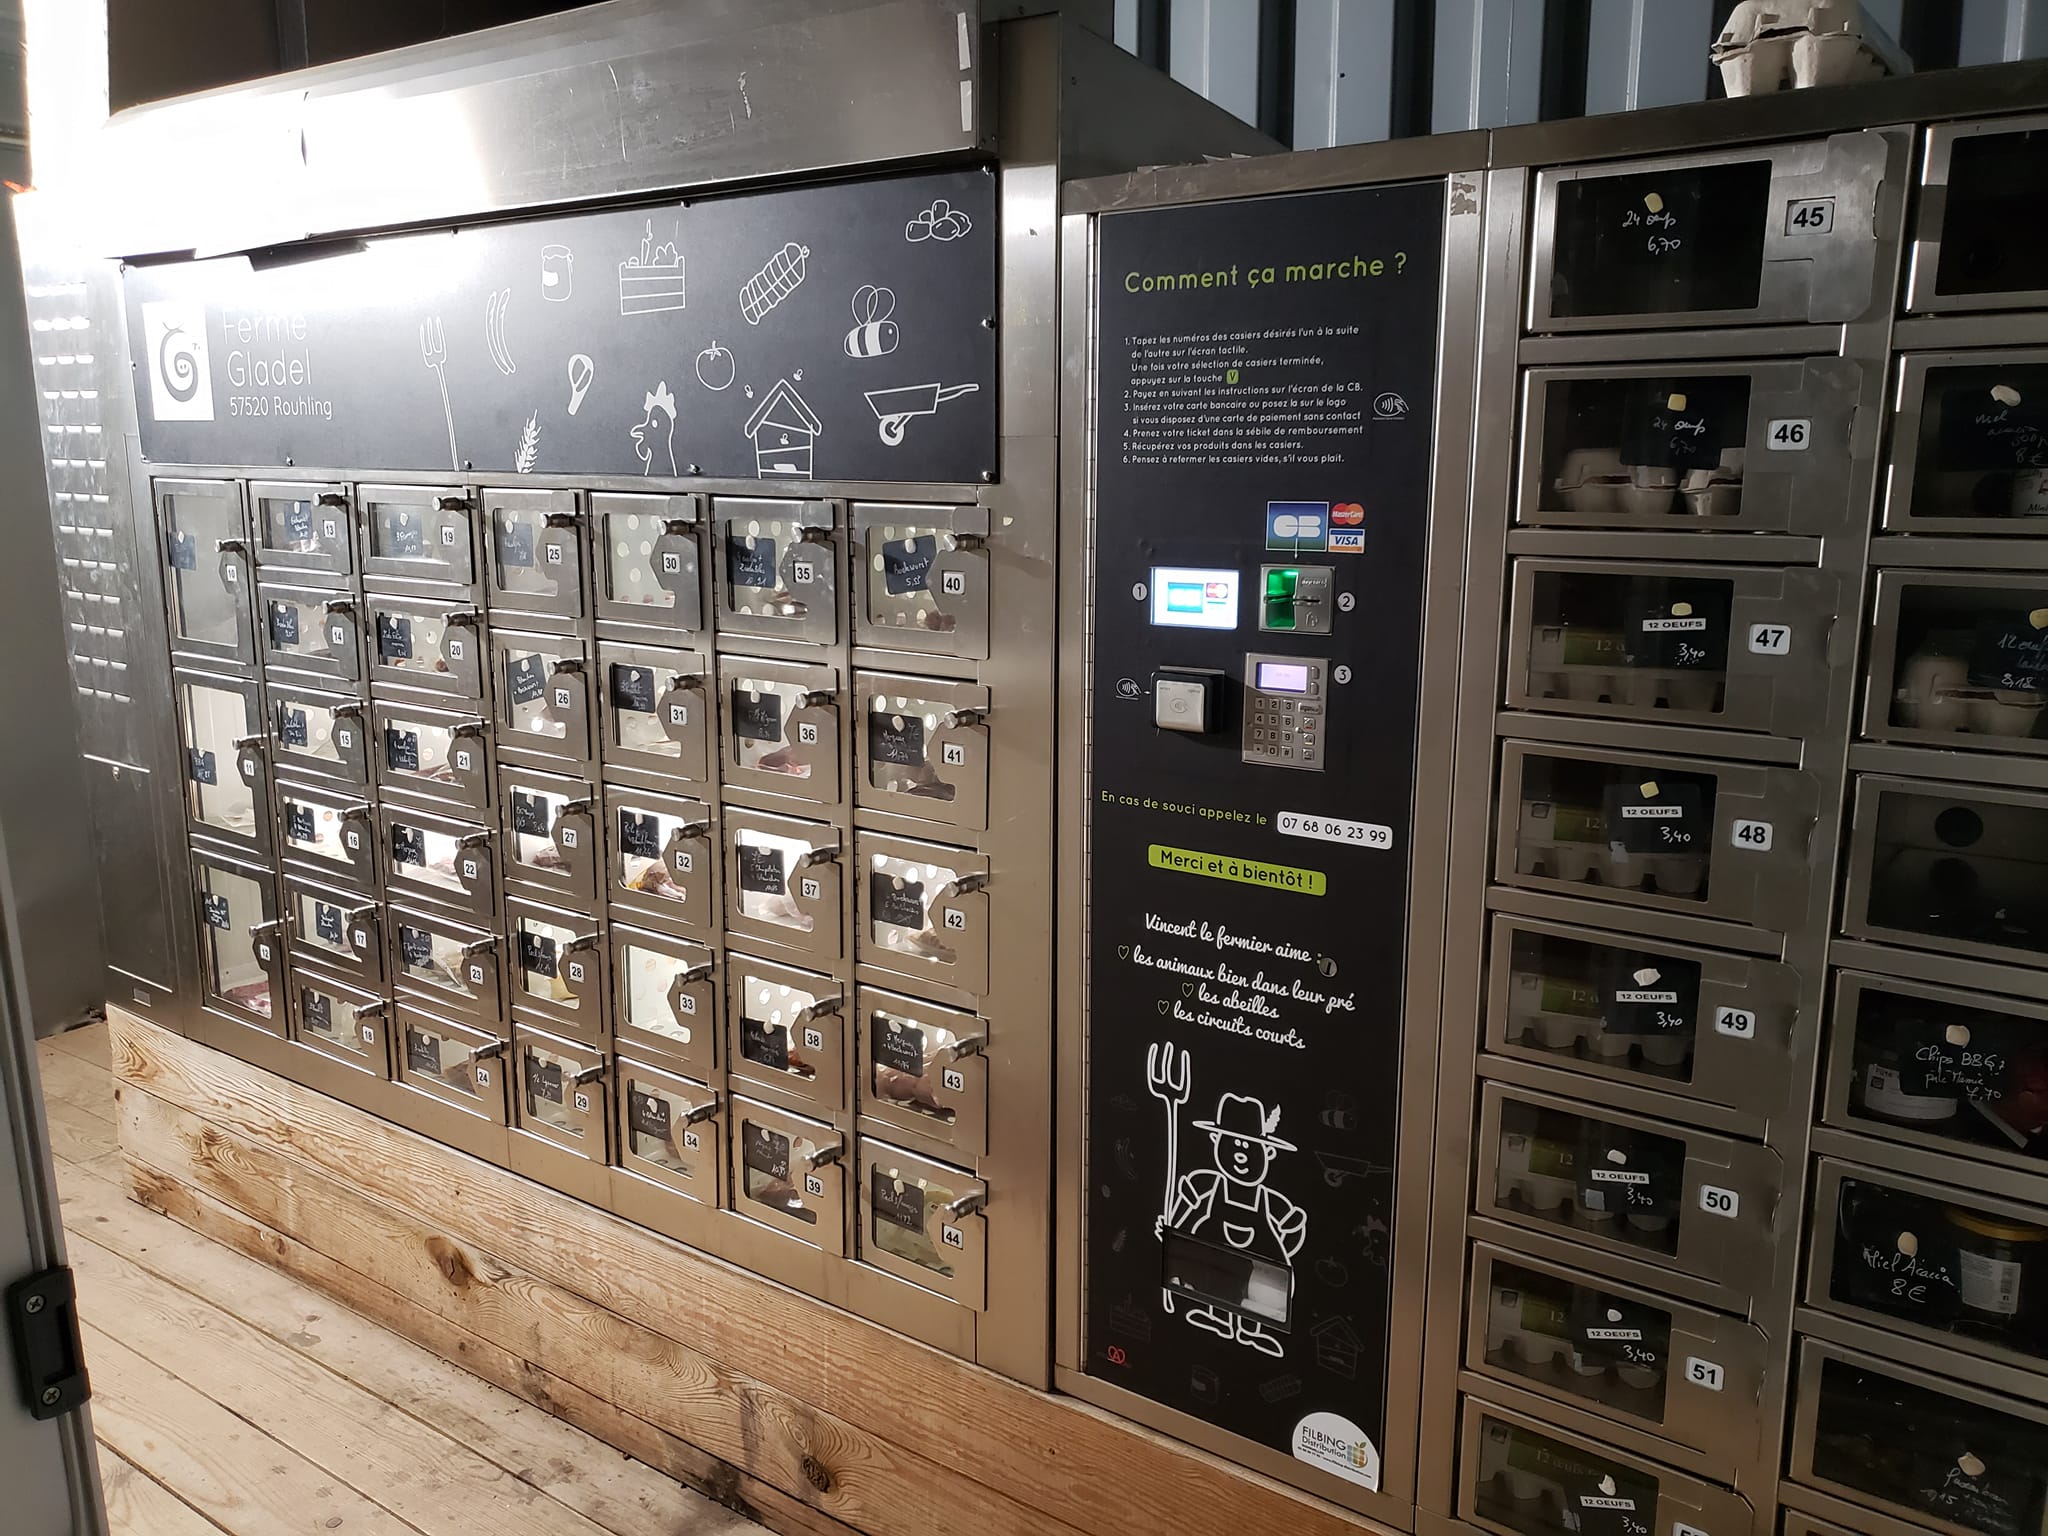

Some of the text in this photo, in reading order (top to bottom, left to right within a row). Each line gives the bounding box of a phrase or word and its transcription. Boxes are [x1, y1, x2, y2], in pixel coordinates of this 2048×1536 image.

[1793, 206, 1825, 228] 45
[1125, 252, 1408, 293] Comment ça marche ?
[1132, 336, 1157, 346] Tapez
[1160, 335, 1171, 344] les
[1173, 333, 1210, 343] numéros
[1212, 332, 1228, 341] des
[1230, 331, 1260, 340] casiers
[1263, 328, 1296, 339] désirés
[1299, 327, 1314, 337] l'un
[1317, 326, 1323, 336] à
[1325, 327, 1333, 336] la
[1336, 325, 1359, 335] suite
[1131, 345, 1249, 359] de l'autre sur l'écran tactile.
[227, 348, 312, 387] Gladel
[1131, 355, 1324, 372] Une fois votre sélection de casiers terminée,
[1131, 376, 1166, 386] appuyez
[1168, 376, 1181, 384] sur
[1183, 375, 1191, 383] la
[1193, 373, 1223, 383] touche
[1124, 390, 1131, 399] 2.
[1133, 389, 1157, 400] Payez
[1171, 388, 1201, 397] suivant
[1204, 387, 1216, 396] les
[1218, 385, 1269, 395] instructions
[1271, 386, 1285, 394] sur
[1288, 384, 1319, 393] l'écran
[1321, 384, 1334, 392] de
[1336, 383, 1344, 392] la
[1347, 382, 1364, 392] CB.
[230, 396, 333, 421] 57520 Rouhling
[1774, 424, 1805, 443] 46
[1123, 455, 1131, 464] 6.
[1132, 455, 1160, 463] Pensez
[1162, 454, 1168, 463] à
[1169, 454, 1206, 463] refermer
[1208, 454, 1220, 463] les
[1222, 454, 1253, 463] casiers
[1255, 454, 1281, 464] vides,
[1297, 455, 1319, 463] vous
[1331, 510, 1364, 520] MasterCard
[325, 522, 334, 535] 13
[444, 530, 454, 544] 19
[1335, 536, 1359, 546] VISA
[549, 549, 560, 560] 25
[665, 558, 677, 569] 30
[797, 567, 810, 580] 35
[946, 577, 960, 591] 40
[334, 630, 342, 642] 14
[1755, 629, 1785, 648] 47
[451, 644, 461, 657] 20
[558, 693, 569, 704] 26
[673, 709, 684, 721] 31
[341, 733, 350, 746] 15
[802, 728, 815, 741] 36
[459, 754, 468, 767] 21
[948, 749, 961, 762] 41
[246, 762, 253, 773] 11
[1102, 790, 1267, 825] En cas de souci appelez le
[1625, 808, 1679, 817] 12 OEUFS
[1282, 816, 1387, 843] 07 68 06 23 99
[1738, 825, 1766, 844] 48
[564, 833, 575, 843] 27
[678, 856, 690, 868] 32
[465, 863, 475, 875] 22
[1160, 850, 1203, 871] Merci
[1207, 859, 1223, 875] et
[1228, 860, 1239, 877] à
[1243, 863, 1303, 888] bientôt
[804, 884, 816, 896] 37
[948, 913, 962, 927] 42
[356, 933, 364, 945] 17
[1145, 912, 1312, 962] Vincent le fermier aime
[262, 947, 269, 958] 12
[472, 969, 482, 981] 23
[571, 966, 582, 978] 28
[1133, 944, 1356, 1014] les animaux bien dans leur pré
[1198, 982, 1280, 1019] les abeilles
[1621, 993, 1673, 1002] 12 OEUFS
[1173, 1000, 1306, 1049] les circuits courts
[1721, 1012, 1748, 1031] 49
[807, 1034, 819, 1046] 38
[479, 1072, 489, 1083] 24
[946, 1075, 961, 1089] 43
[686, 1136, 697, 1147] 34
[808, 1181, 821, 1192] 39
[1705, 1191, 1733, 1212] 50
[946, 1232, 960, 1246] 44
[1591, 1330, 1640, 1340] 12 OEUFS
[1693, 1363, 1718, 1385] 51
[1302, 1425, 1346, 1451] FILBING
[1301, 1435, 1347, 1460] Distribution
